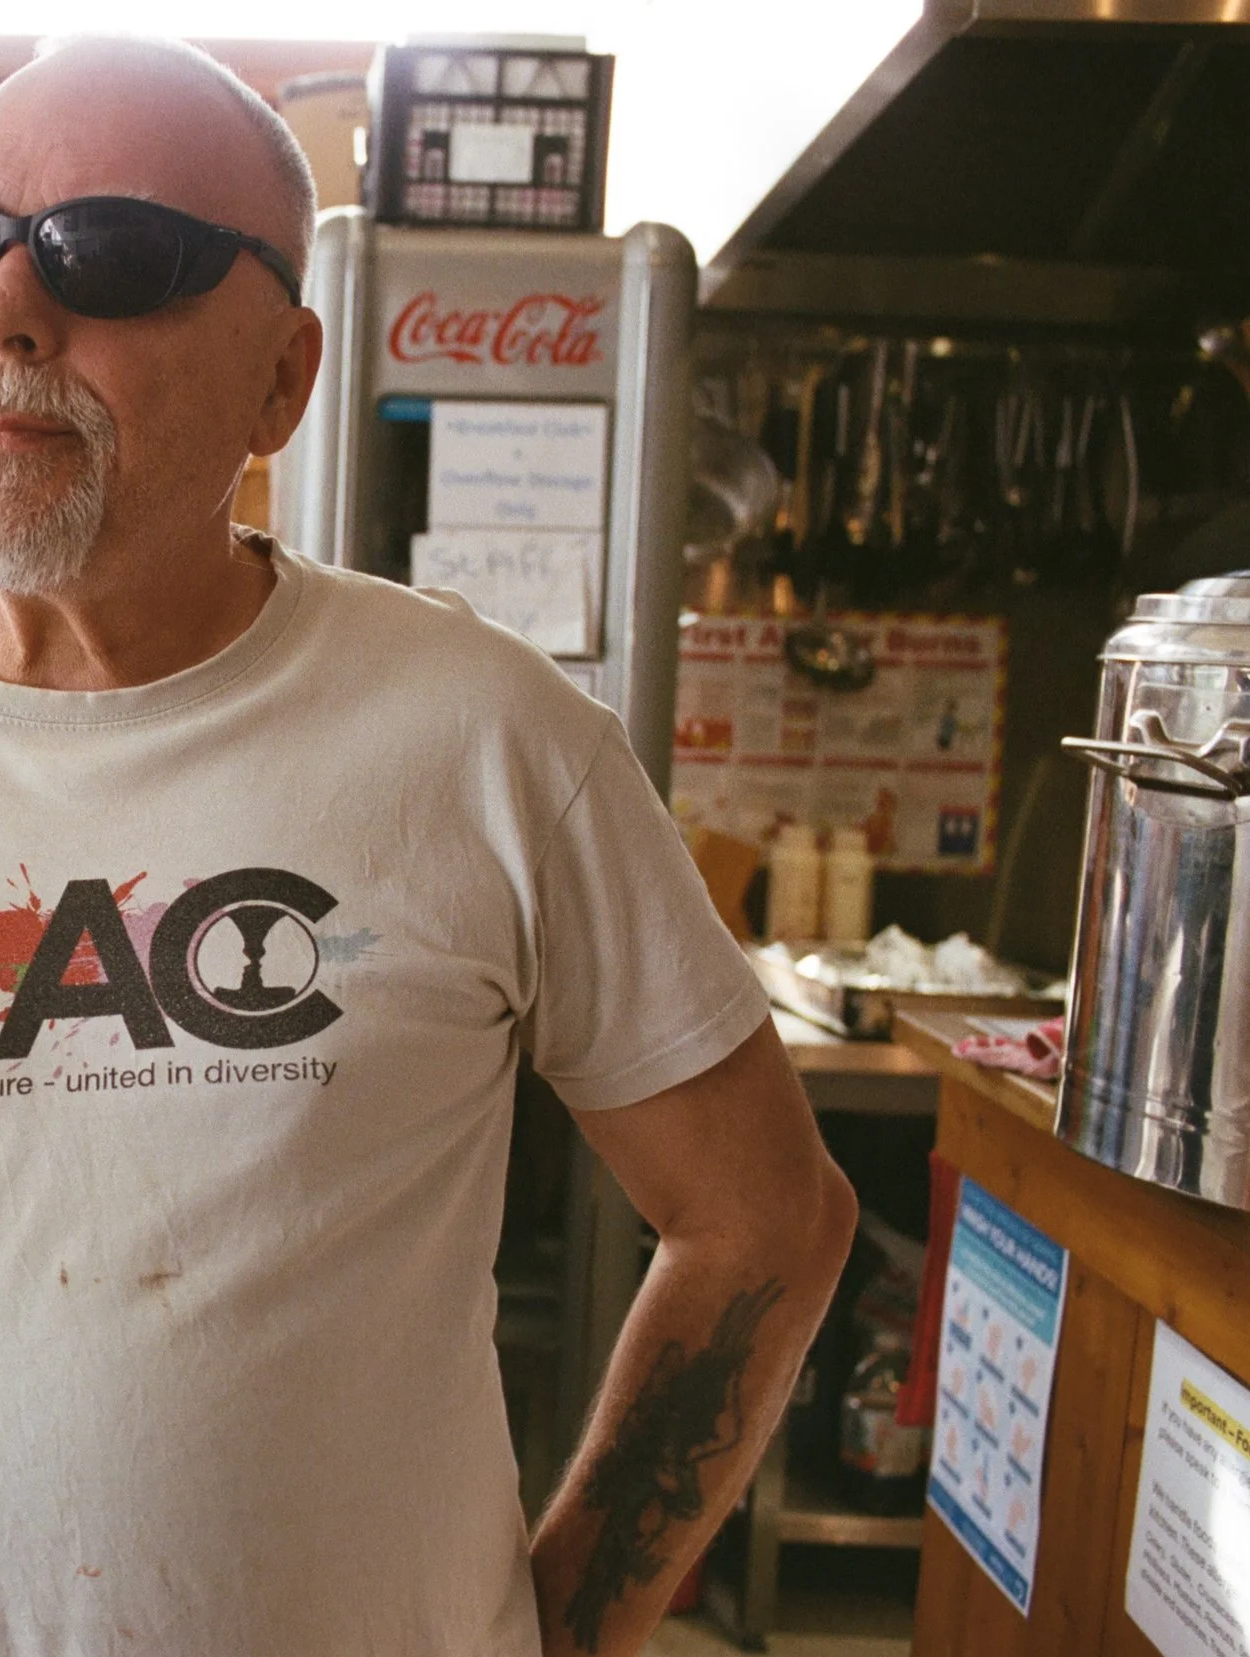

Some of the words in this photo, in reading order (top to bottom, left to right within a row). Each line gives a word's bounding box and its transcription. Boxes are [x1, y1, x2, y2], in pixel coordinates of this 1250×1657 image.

[389, 289, 607, 366] Coca-Cola
[66, 1062, 155, 1092] united
[167, 1061, 192, 1084] in
[204, 1056, 337, 1086] diversity
[1181, 1384, 1225, 1435] Important
